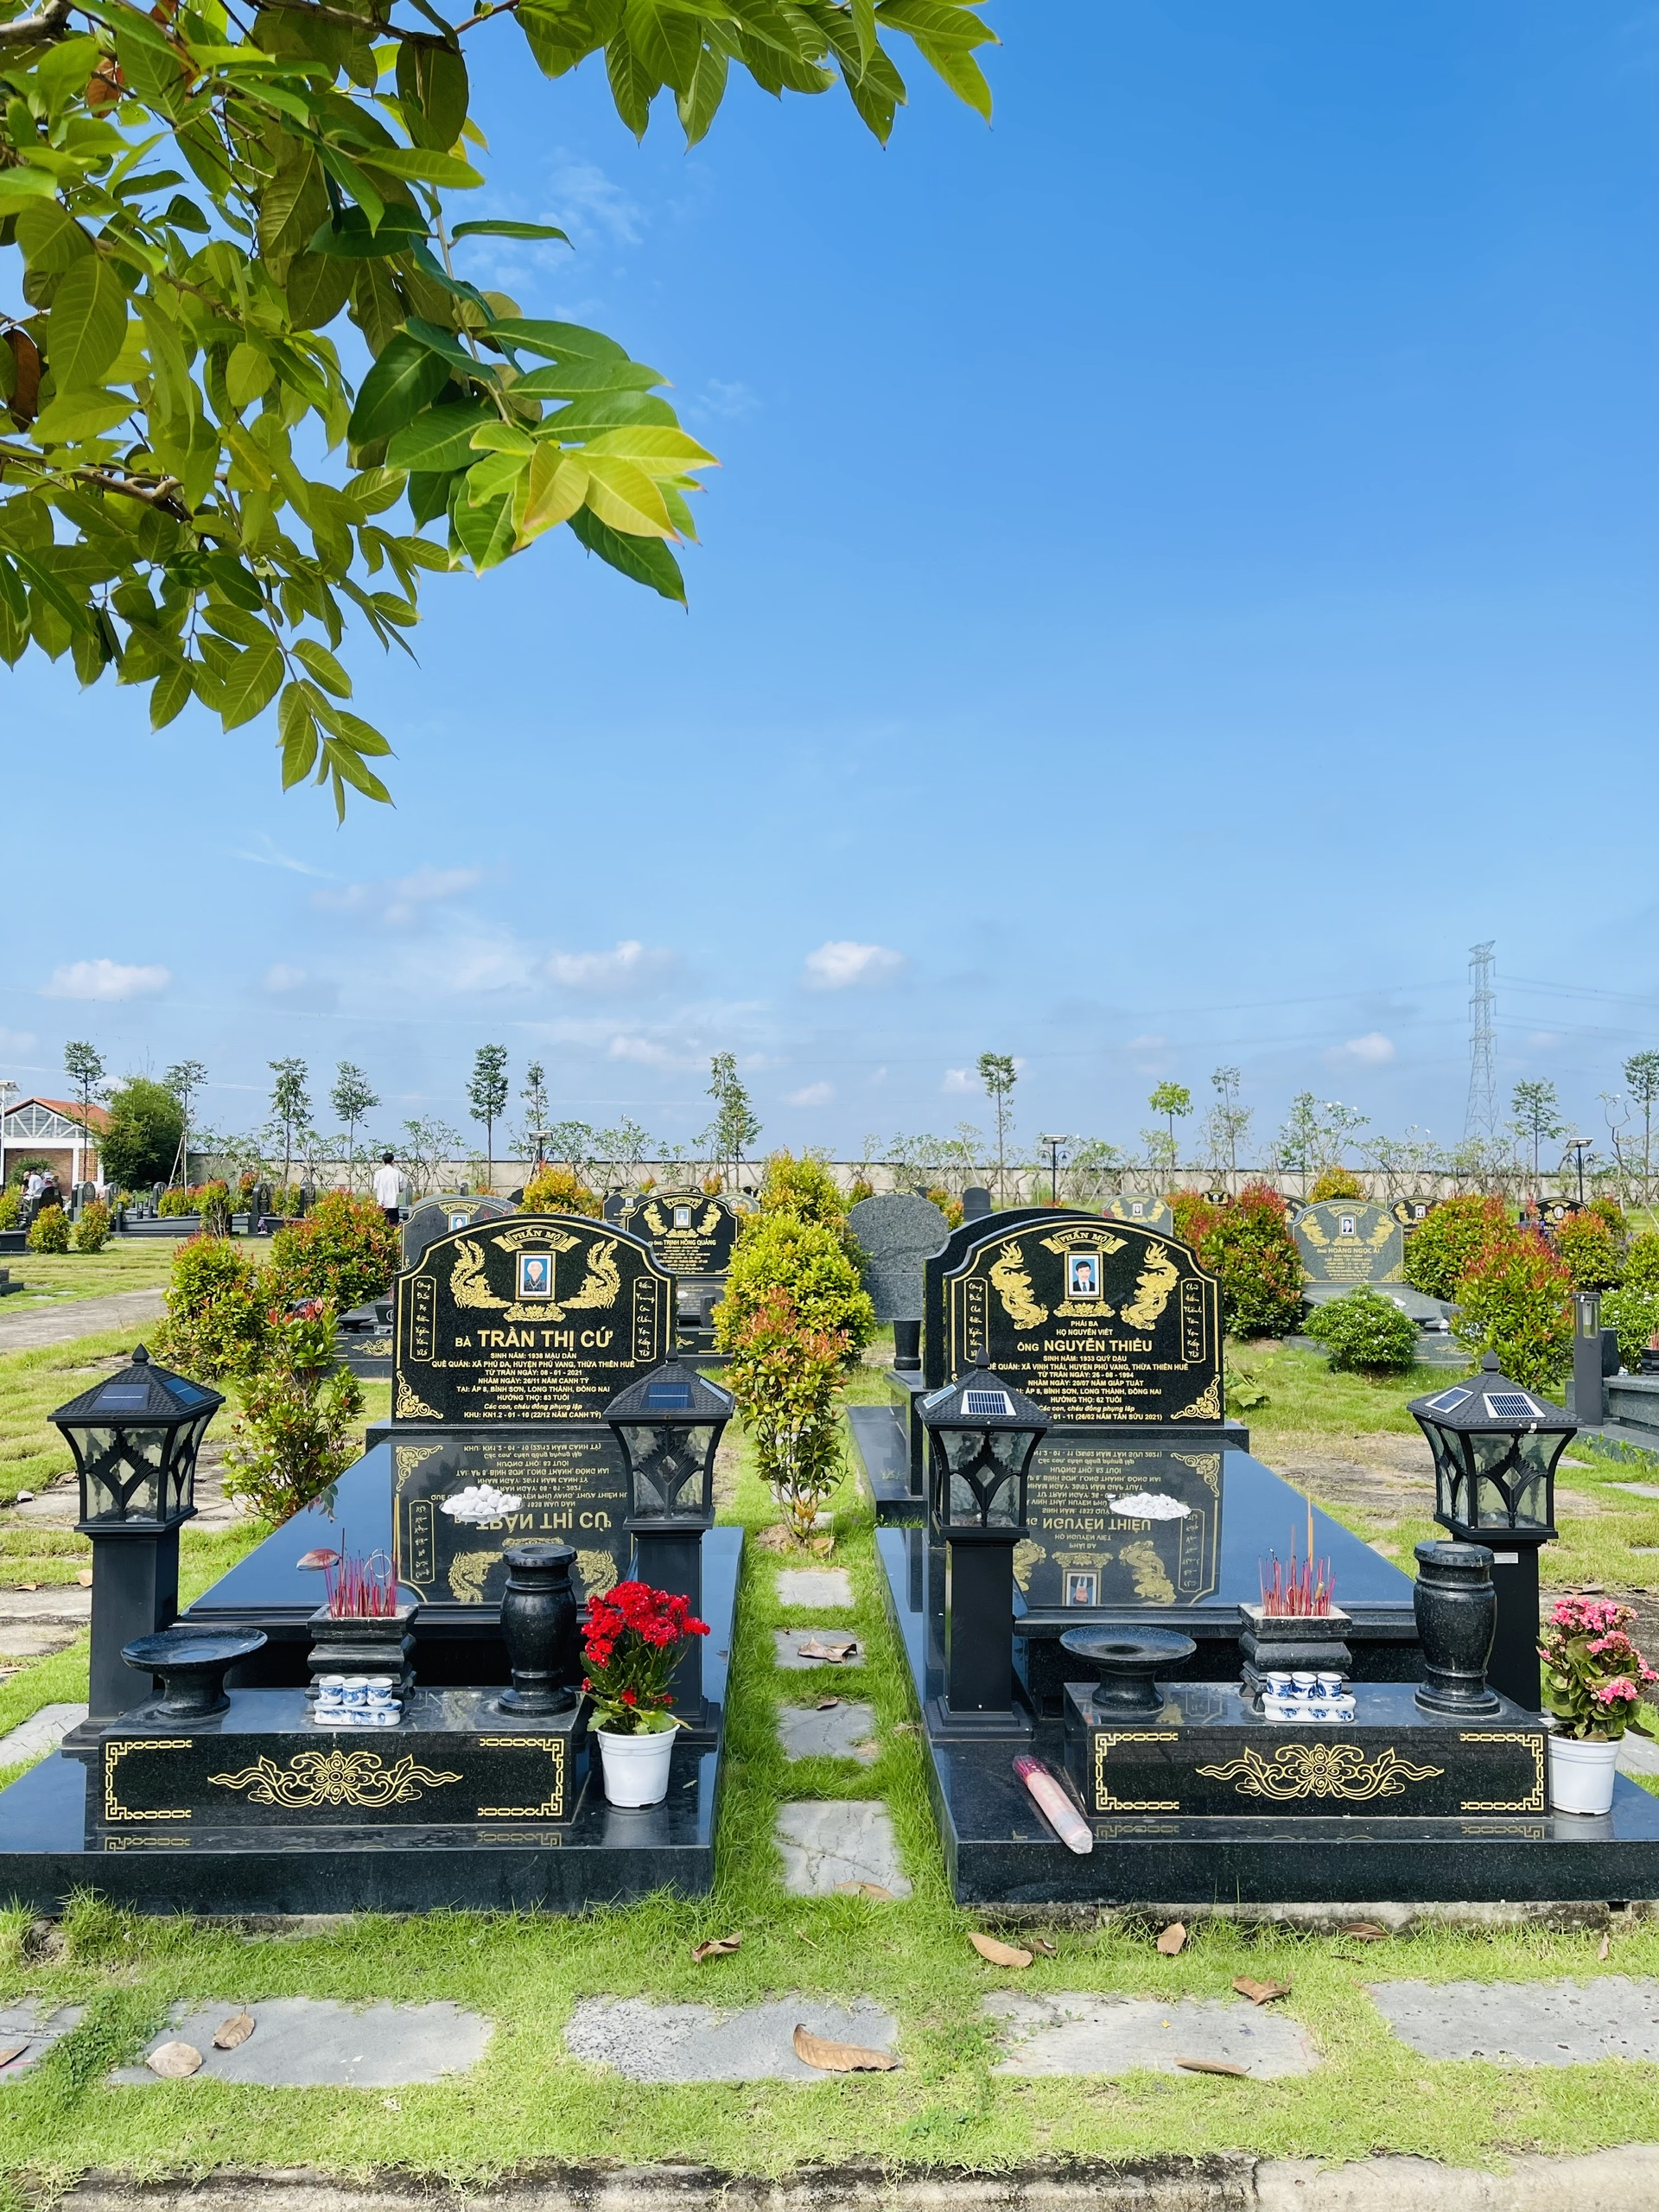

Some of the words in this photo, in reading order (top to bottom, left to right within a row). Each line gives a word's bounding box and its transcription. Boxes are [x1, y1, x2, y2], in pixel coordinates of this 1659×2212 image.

[512, 1229, 543, 1240] PHẦN
[545, 1231, 562, 1241] MỘ
[1059, 1231, 1089, 1243] PHẦN
[1092, 1233, 1108, 1243] MỘ
[455, 1335, 471, 1347] BÀ
[477, 1326, 534, 1347] TRẦN
[541, 1330, 574, 1351] THỊ
[581, 1326, 613, 1348] CỨ
[1017, 1341, 1039, 1351] ÔNG
[1045, 1338, 1104, 1351] NGUYỄN
